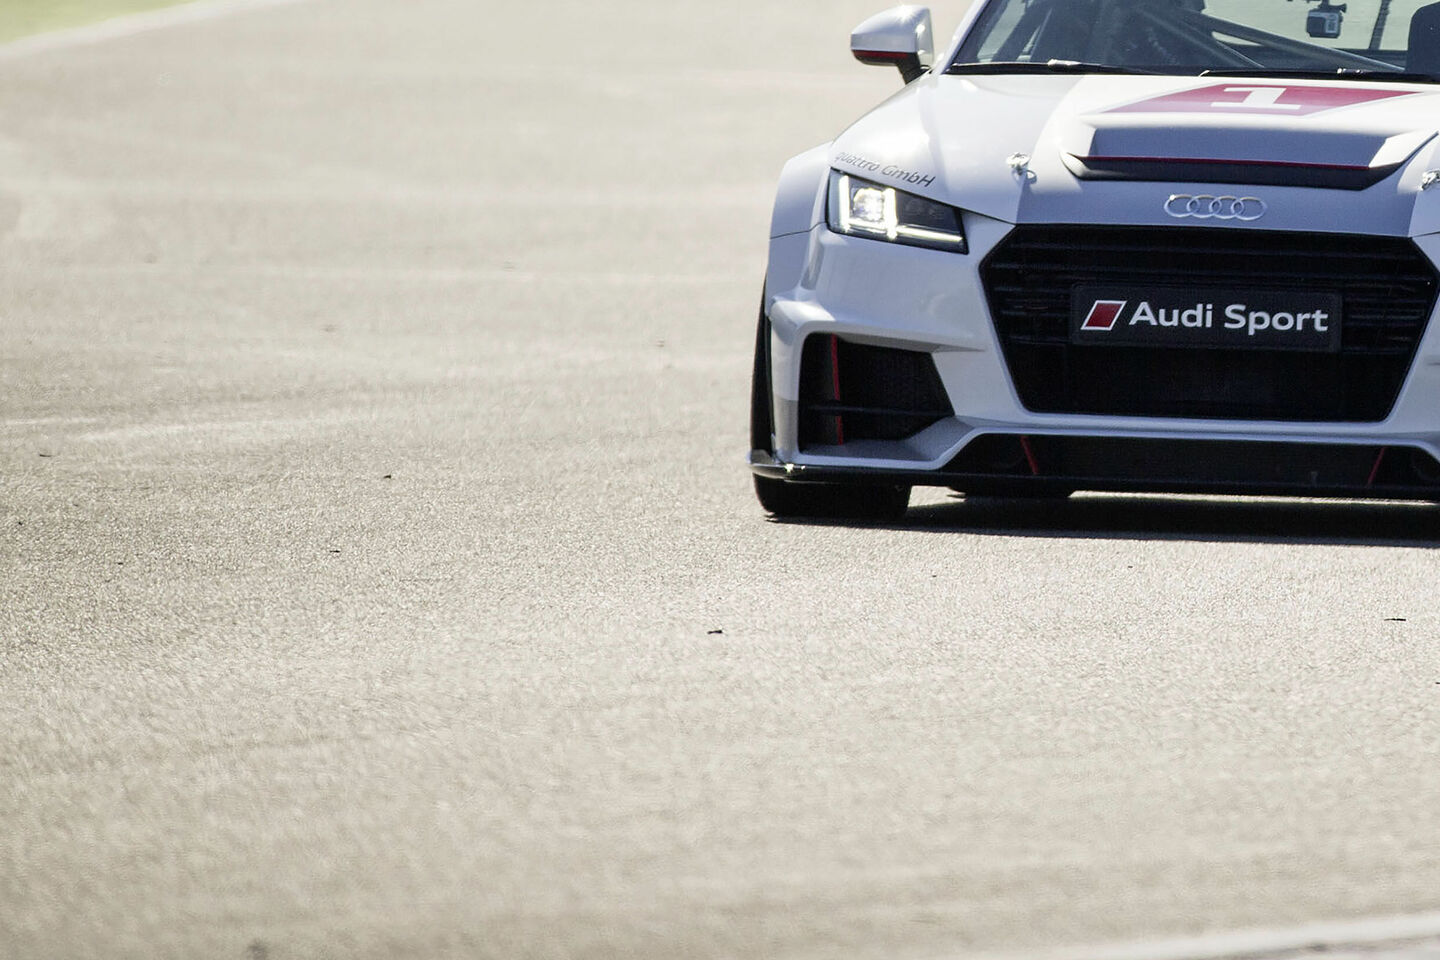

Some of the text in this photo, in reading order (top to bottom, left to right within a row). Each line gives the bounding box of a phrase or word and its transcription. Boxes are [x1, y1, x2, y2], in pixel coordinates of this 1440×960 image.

[881, 165, 936, 188] GmbH
[1129, 301, 1328, 336] Audi Sport
